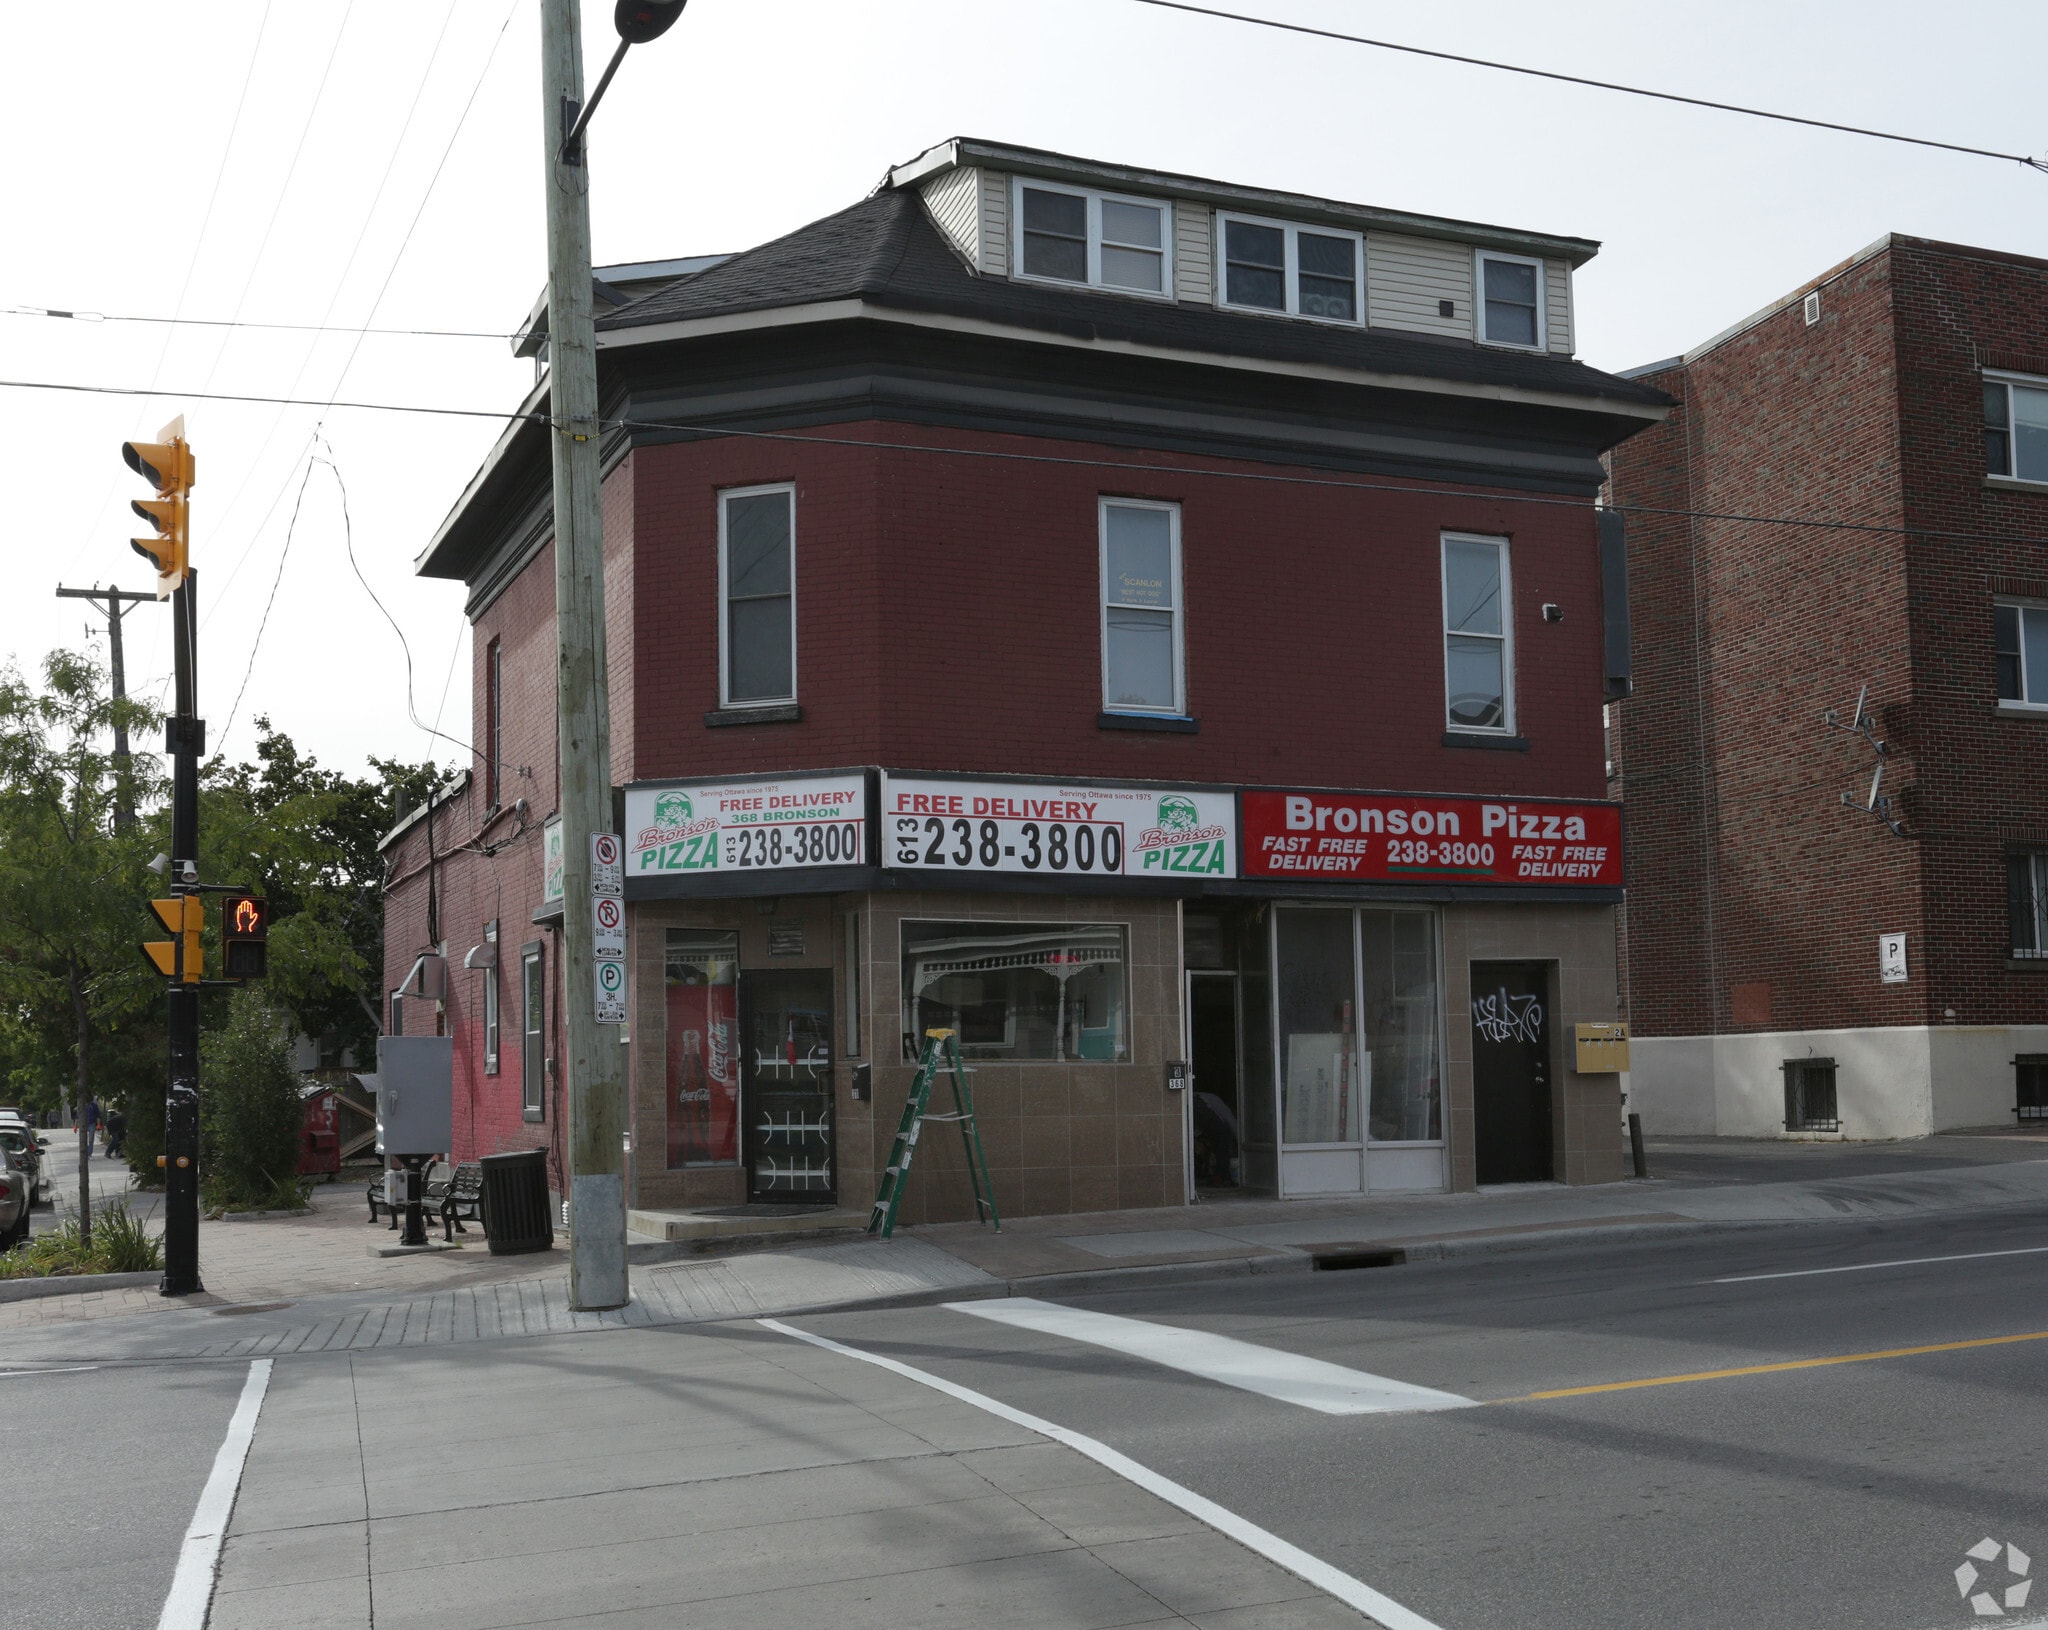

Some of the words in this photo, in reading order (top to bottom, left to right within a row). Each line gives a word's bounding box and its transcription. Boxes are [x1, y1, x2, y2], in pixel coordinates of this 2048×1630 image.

[1124, 578, 1162, 588] SCANLON
[700, 790, 723, 798] Serving
[746, 787, 763, 795] since
[765, 785, 779, 793] 1975
[1059, 789, 1087, 799] Serving
[1088, 791, 1113, 799] Ottawa
[1114, 792, 1134, 800] since
[1135, 793, 1152, 801] 1975
[719, 797, 763, 812] FREE
[769, 791, 856, 809] DELIVERY
[897, 793, 963, 814] FREE
[973, 797, 1098, 820] DELIVERY
[731, 812, 758, 823] 368
[763, 807, 840, 821] BRONSON
[1285, 796, 1460, 836] Bronson
[1482, 804, 1586, 840] Pizza
[631, 818, 720, 853] Bronson
[739, 823, 856, 867] 238-3800
[896, 818, 919, 864] 613
[924, 817, 1121, 872] 238-3800
[1133, 824, 1226, 853] Bronson
[1262, 836, 1310, 852] FAST
[1318, 838, 1368, 854] FREE
[640, 832, 718, 869] PIZZA
[726, 836, 737, 863] 613
[1143, 840, 1225, 874] PIZZA
[1387, 840, 1494, 866] 238-3800
[1511, 845, 1556, 860] FAST
[1562, 846, 1607, 861] FREE
[1268, 854, 1362, 871] DELIVERY
[1518, 862, 1602, 878] DELIVERY
[1889, 943, 1898, 958] P
[606, 970, 615, 984] P
[1614, 1028, 1626, 1037] 2A
[1170, 1079, 1183, 1088] 368
